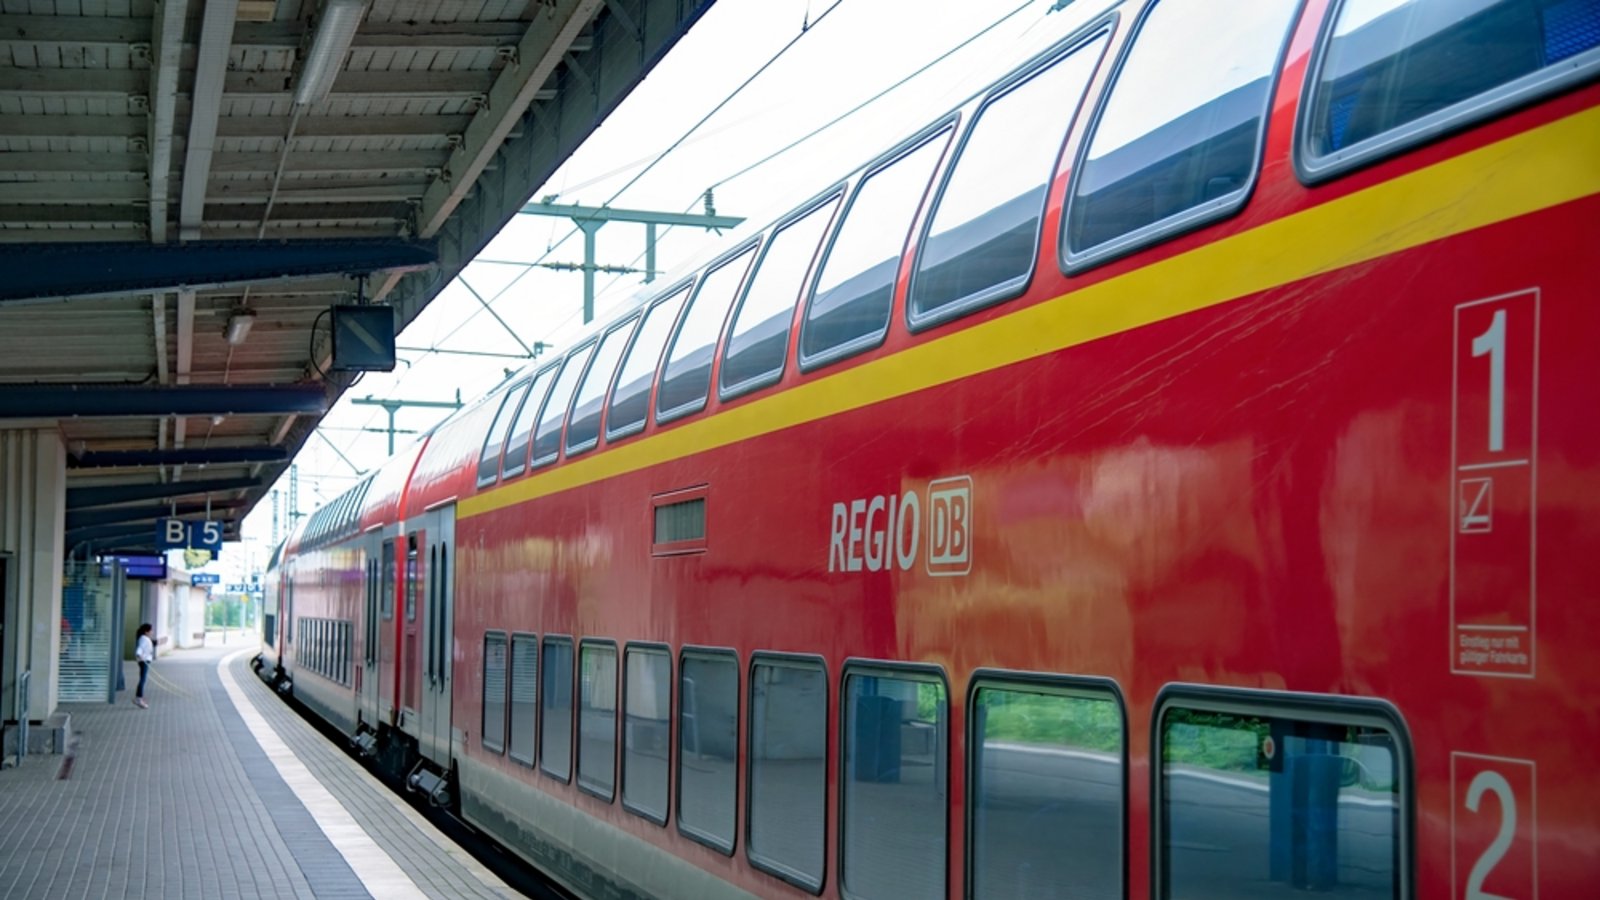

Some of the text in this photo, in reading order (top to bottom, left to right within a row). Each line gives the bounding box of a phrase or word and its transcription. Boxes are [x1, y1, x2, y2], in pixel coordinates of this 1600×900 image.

[1471, 309, 1507, 453] 1
[166, 521, 219, 544] B 5
[829, 490, 968, 573] REGIO DB
[1465, 770, 1517, 900] 2
